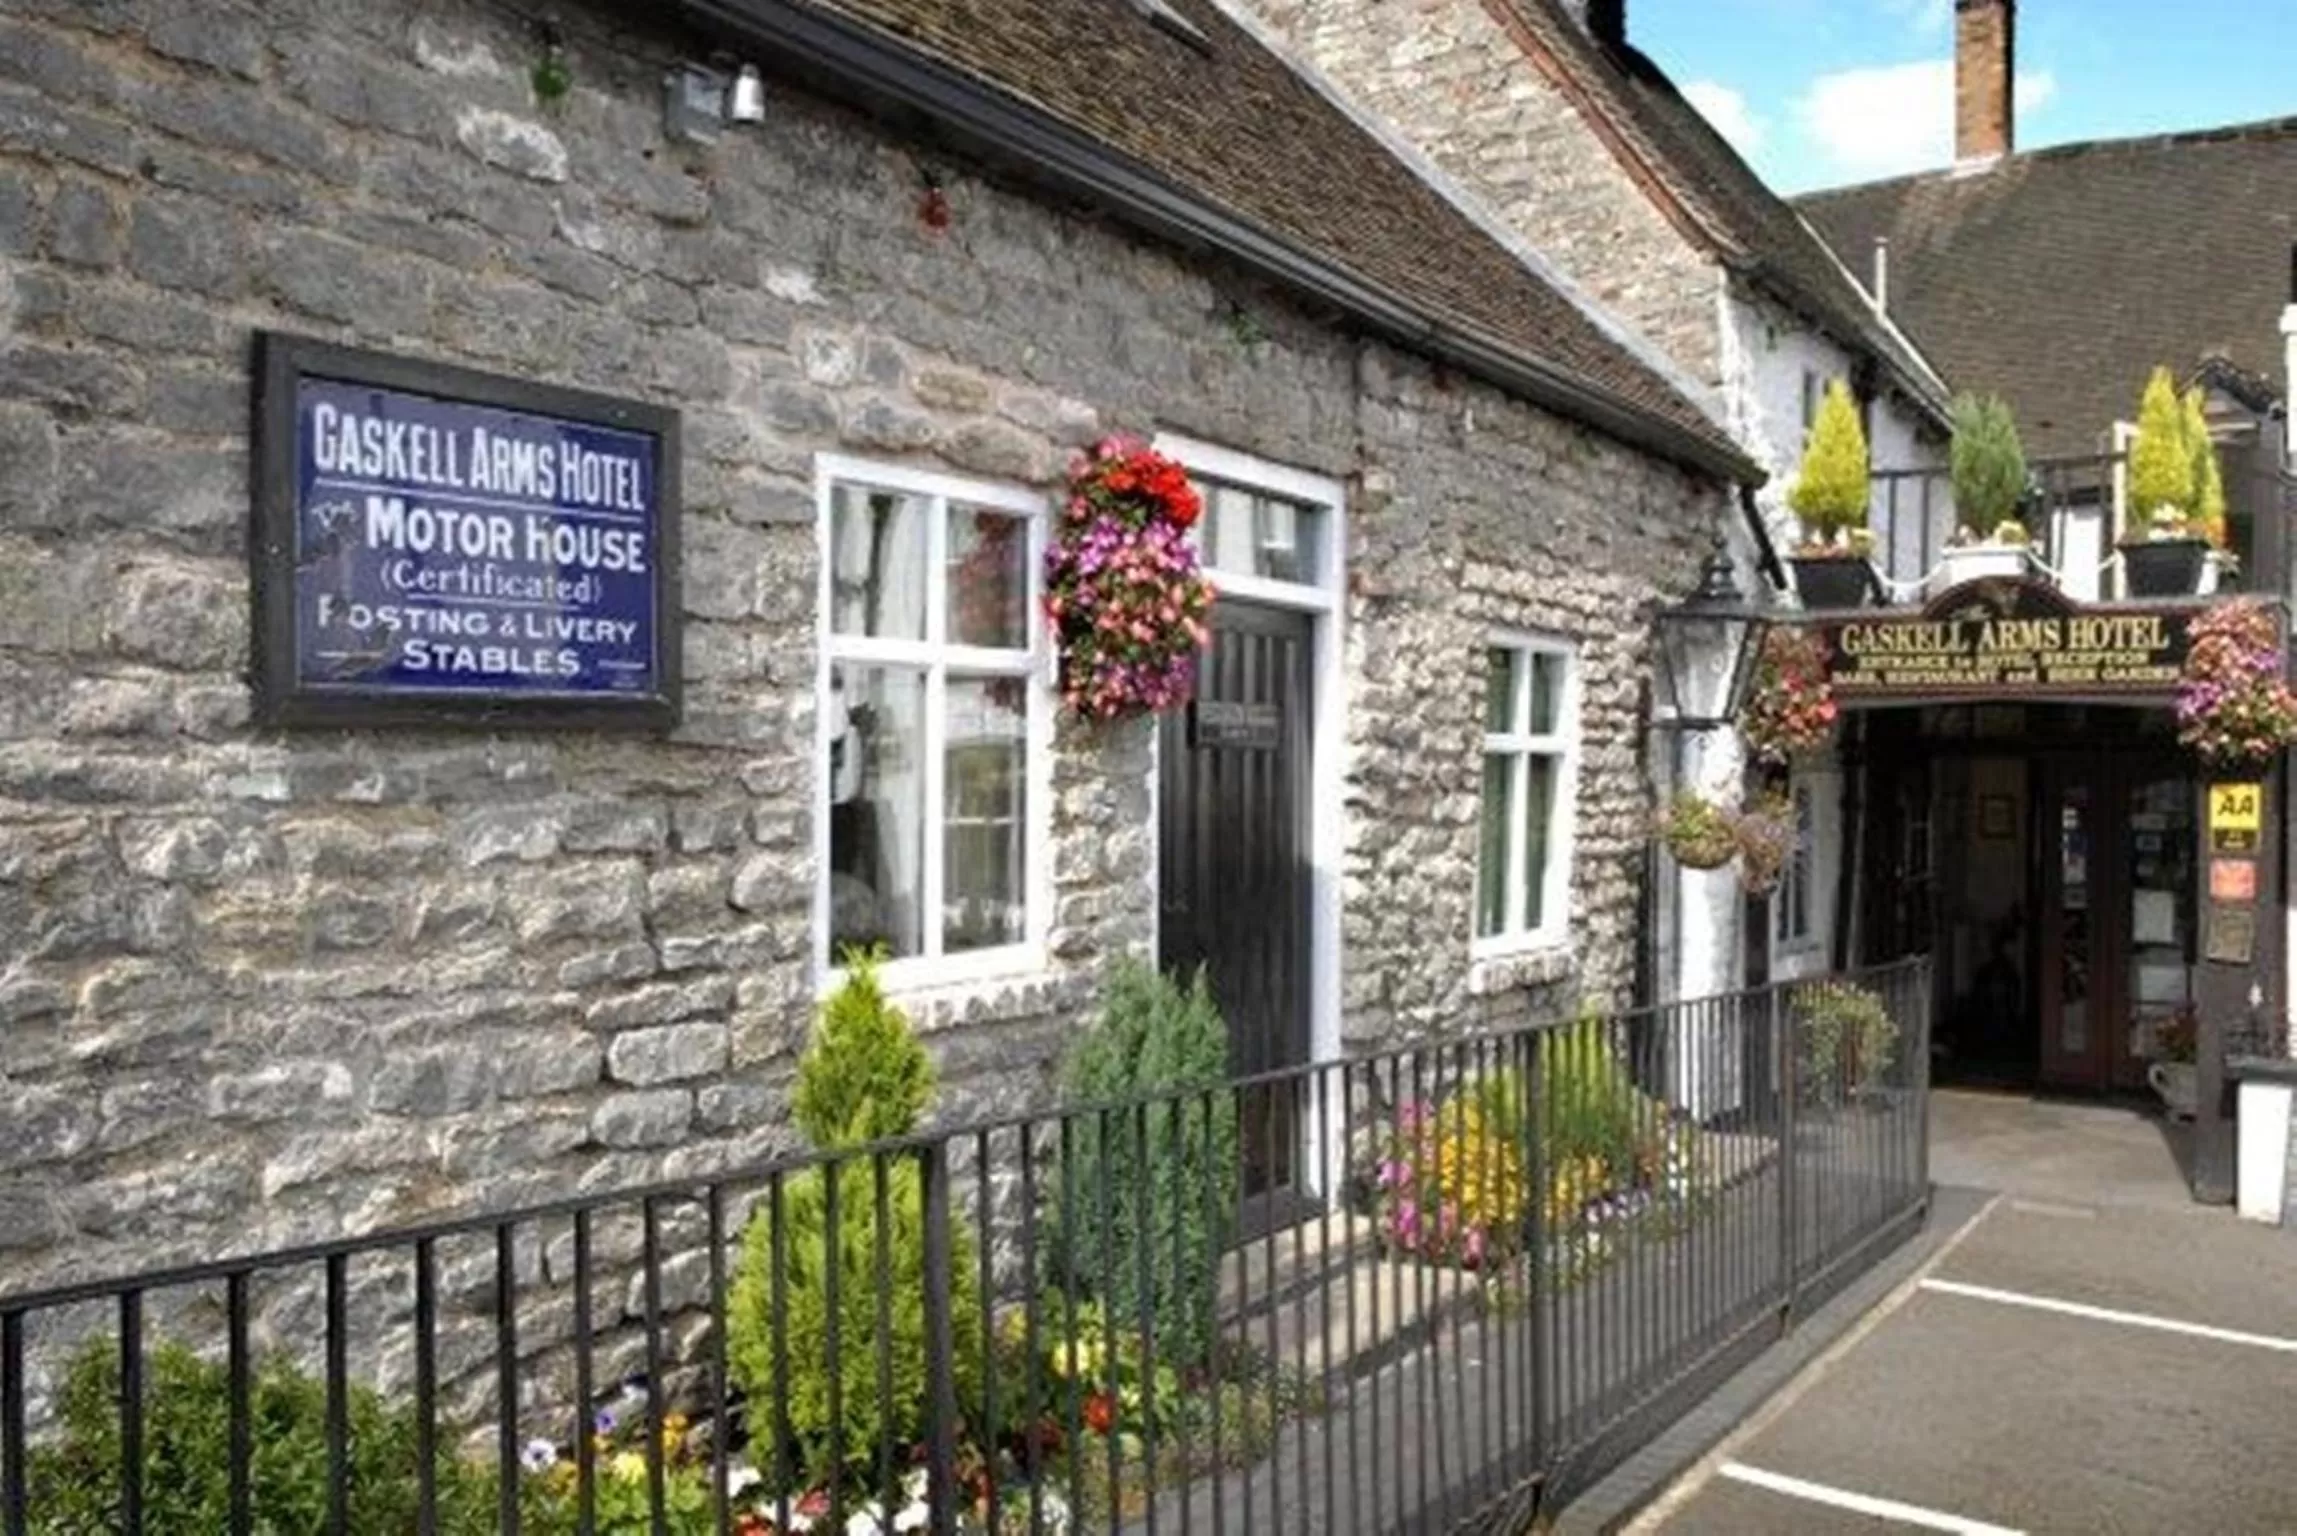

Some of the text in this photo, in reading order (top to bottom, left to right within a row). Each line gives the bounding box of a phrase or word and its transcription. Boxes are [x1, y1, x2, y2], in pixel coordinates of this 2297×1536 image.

[315, 403, 645, 511] GASKELL ARMS HOTEL
[366, 497, 514, 560] MOTOR
[501, 617, 517, 636] &
[526, 617, 638, 644] LIVERY
[1841, 616, 2170, 656] GASKELL ARMS HOTEL
[403, 639, 581, 676] STABLES
[2218, 795, 2254, 815] AA
